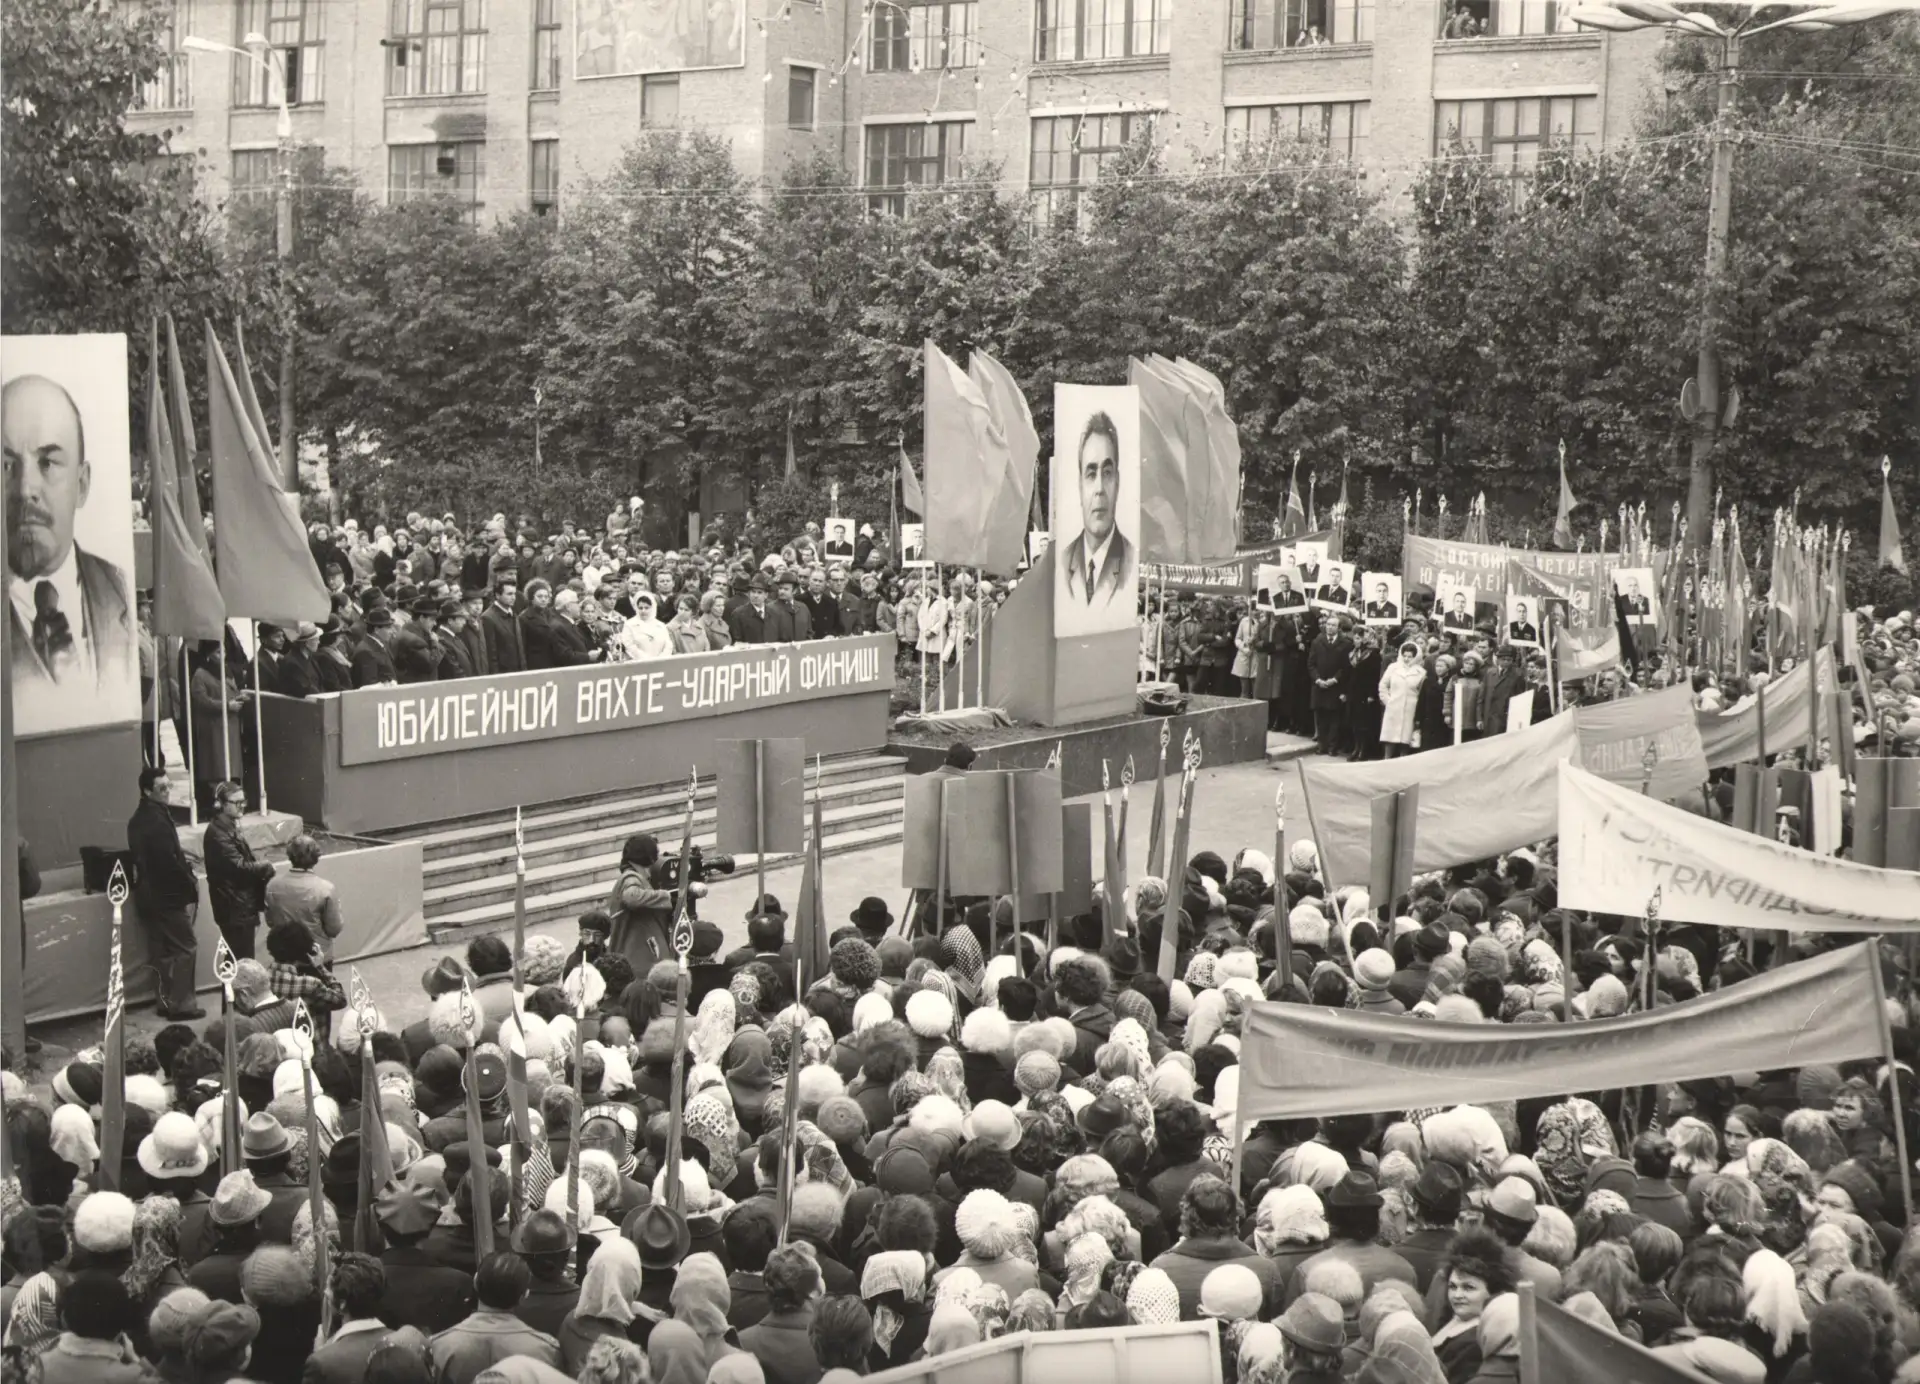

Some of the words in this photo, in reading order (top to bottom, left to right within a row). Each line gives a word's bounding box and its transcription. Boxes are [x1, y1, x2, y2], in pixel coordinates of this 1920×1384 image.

[1433, 546, 1520, 569] ДОСТОЙ
[1536, 557, 1620, 577] ВСТРЕТ
[1419, 566, 1505, 592] ЮИЛЕ
[377, 680, 558, 749] ЮБИЛЕЙНОЙ
[800, 646, 879, 690] ФИНИШ!
